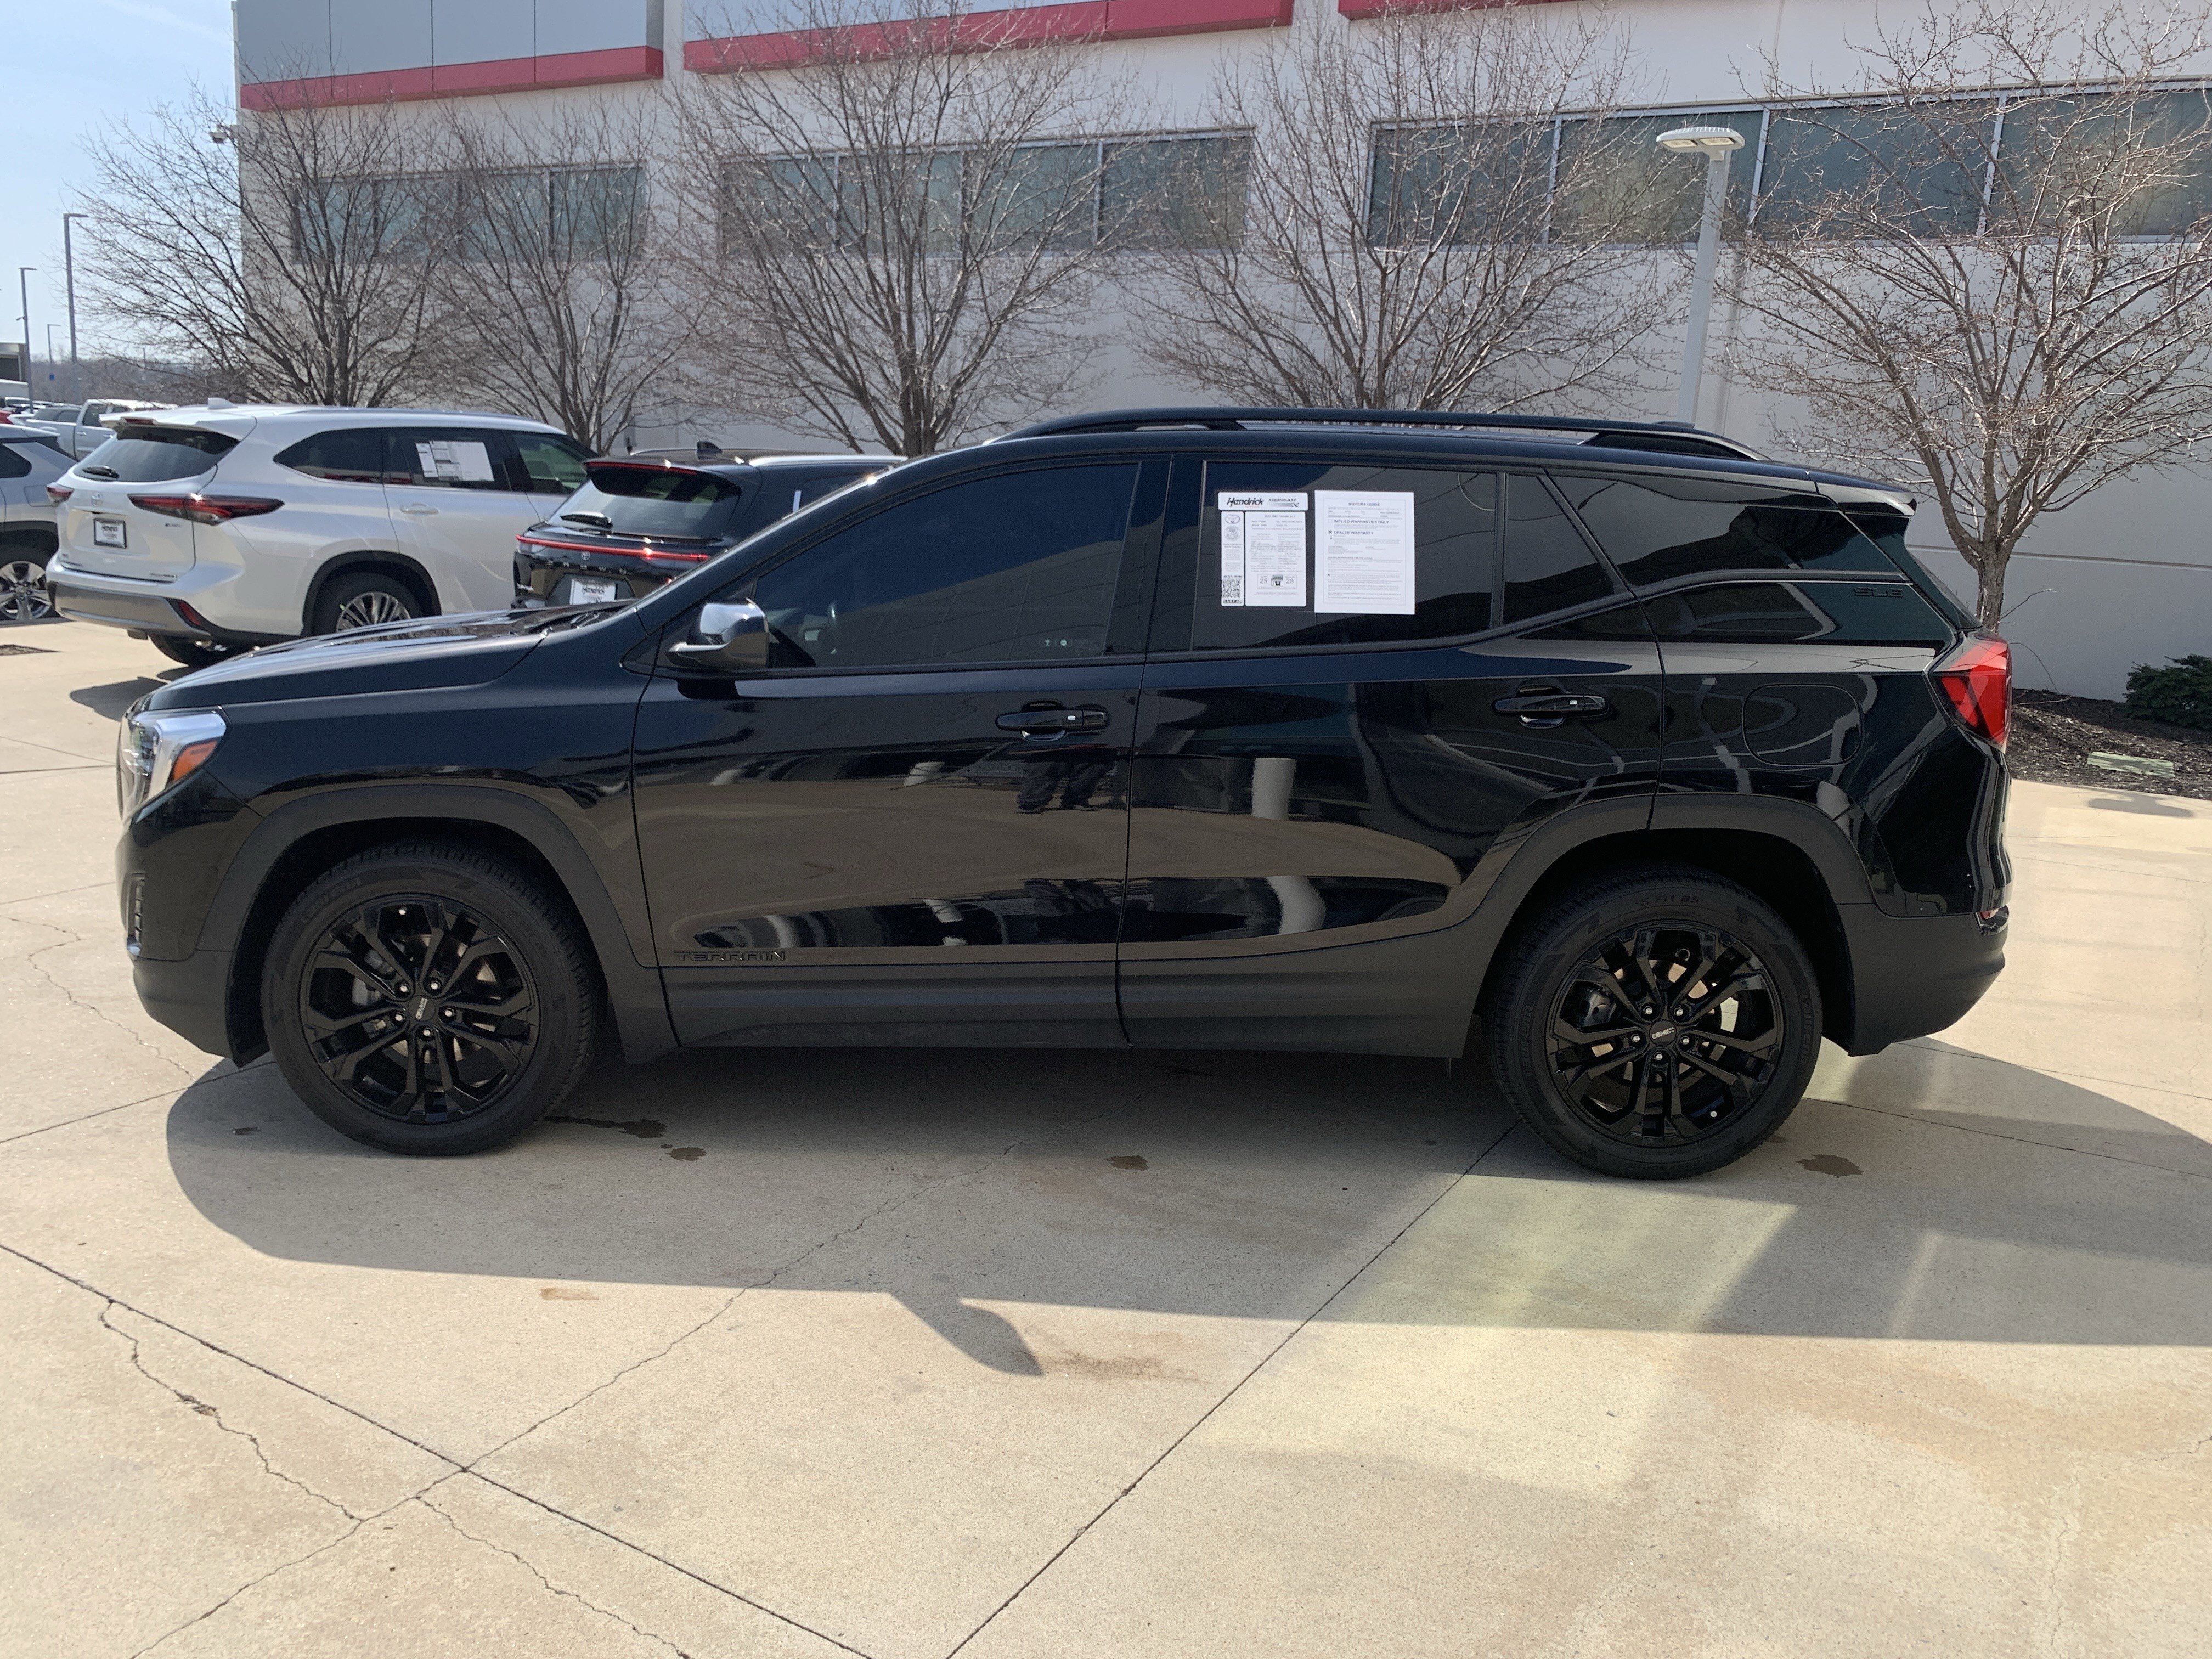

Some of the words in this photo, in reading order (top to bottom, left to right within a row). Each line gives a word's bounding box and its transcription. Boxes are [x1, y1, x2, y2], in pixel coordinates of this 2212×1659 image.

[1227, 497, 1264, 507] Hendrick
[1854, 587, 1903, 598] SLE
[674, 951, 786, 961] TERRAIN
[1651, 1026, 1675, 1039] GMC
